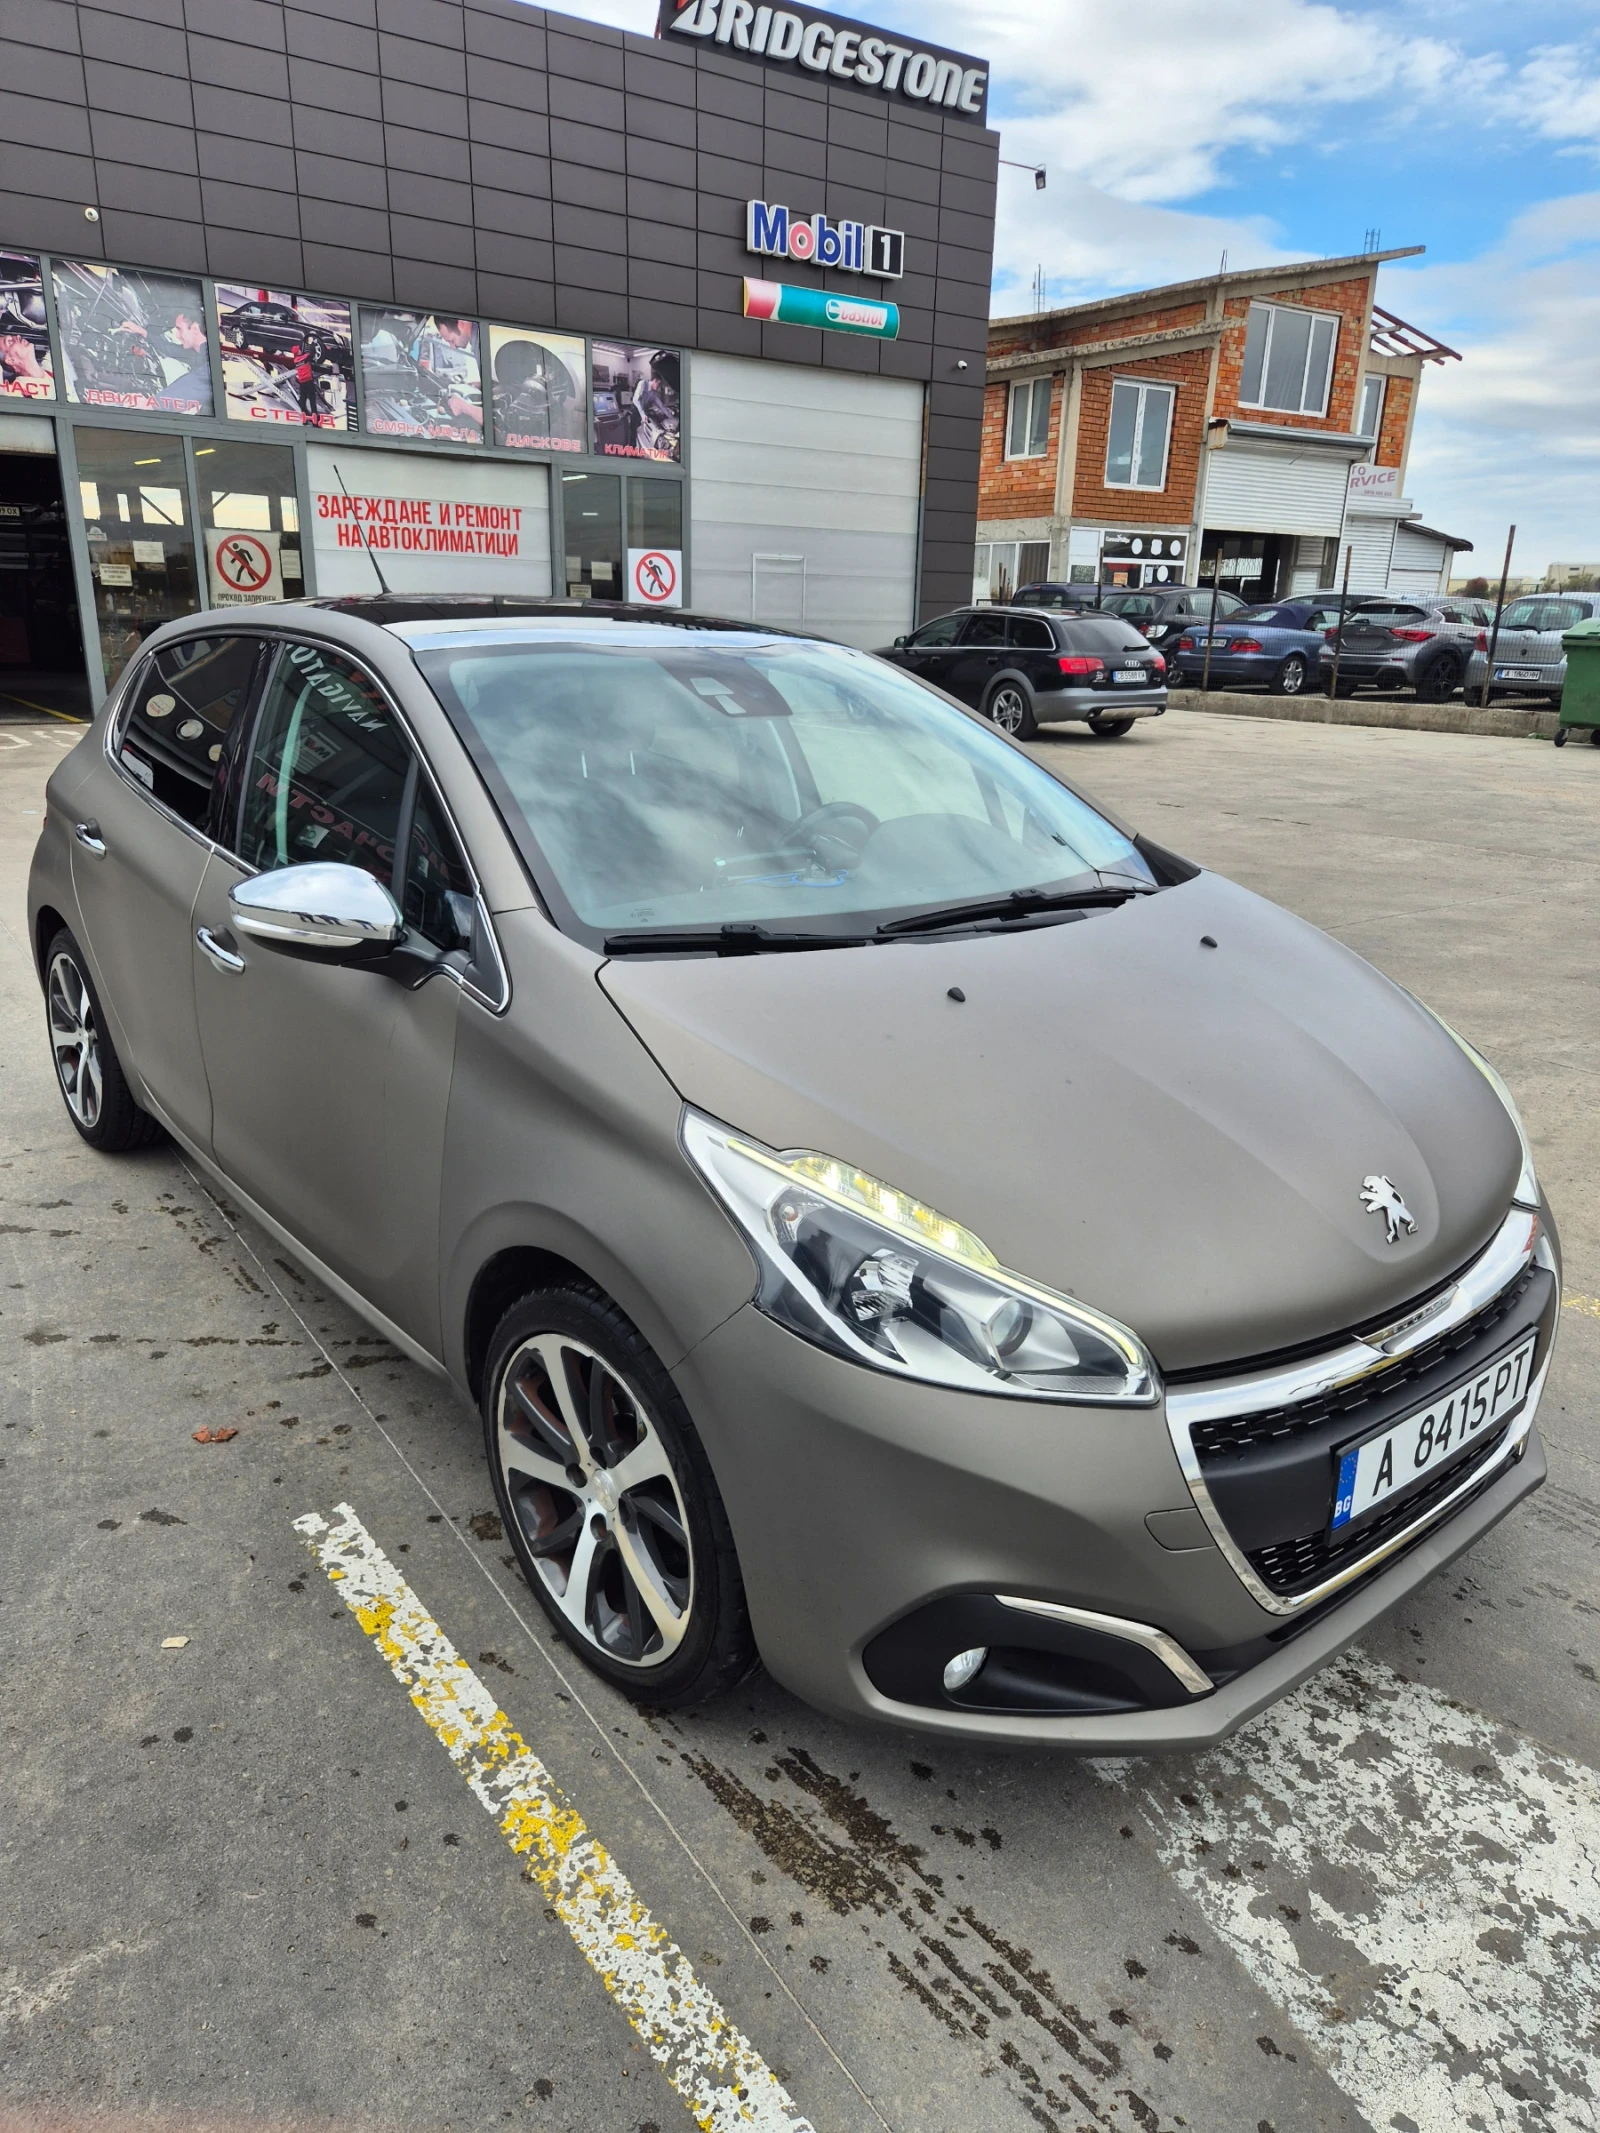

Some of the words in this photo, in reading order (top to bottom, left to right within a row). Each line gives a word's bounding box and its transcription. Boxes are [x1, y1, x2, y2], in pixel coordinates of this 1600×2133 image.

[670, 0, 988, 113] BRIDGESTONE
[747, 200, 864, 272] Mobil
[86, 389, 200, 413] ДВИГАТЕЛ
[251, 406, 336, 428] СТЕНД
[374, 418, 424, 436] СМЯНА
[428, 424, 477, 441] МАСЛА
[506, 433, 581, 452] ДИСКОВЕ
[604, 443, 669, 459] КЛИМАТИК
[317, 494, 432, 525] ЗАРЕЖДАНЕ
[439, 502, 451, 526] И
[455, 504, 522, 531] РЕМОНТ
[337, 523, 363, 548] НА
[367, 525, 519, 557] АВТОКЛИМАТИЦИ
[1372, 1437, 1393, 1497] A
[1334, 1495, 1351, 1518] BG
